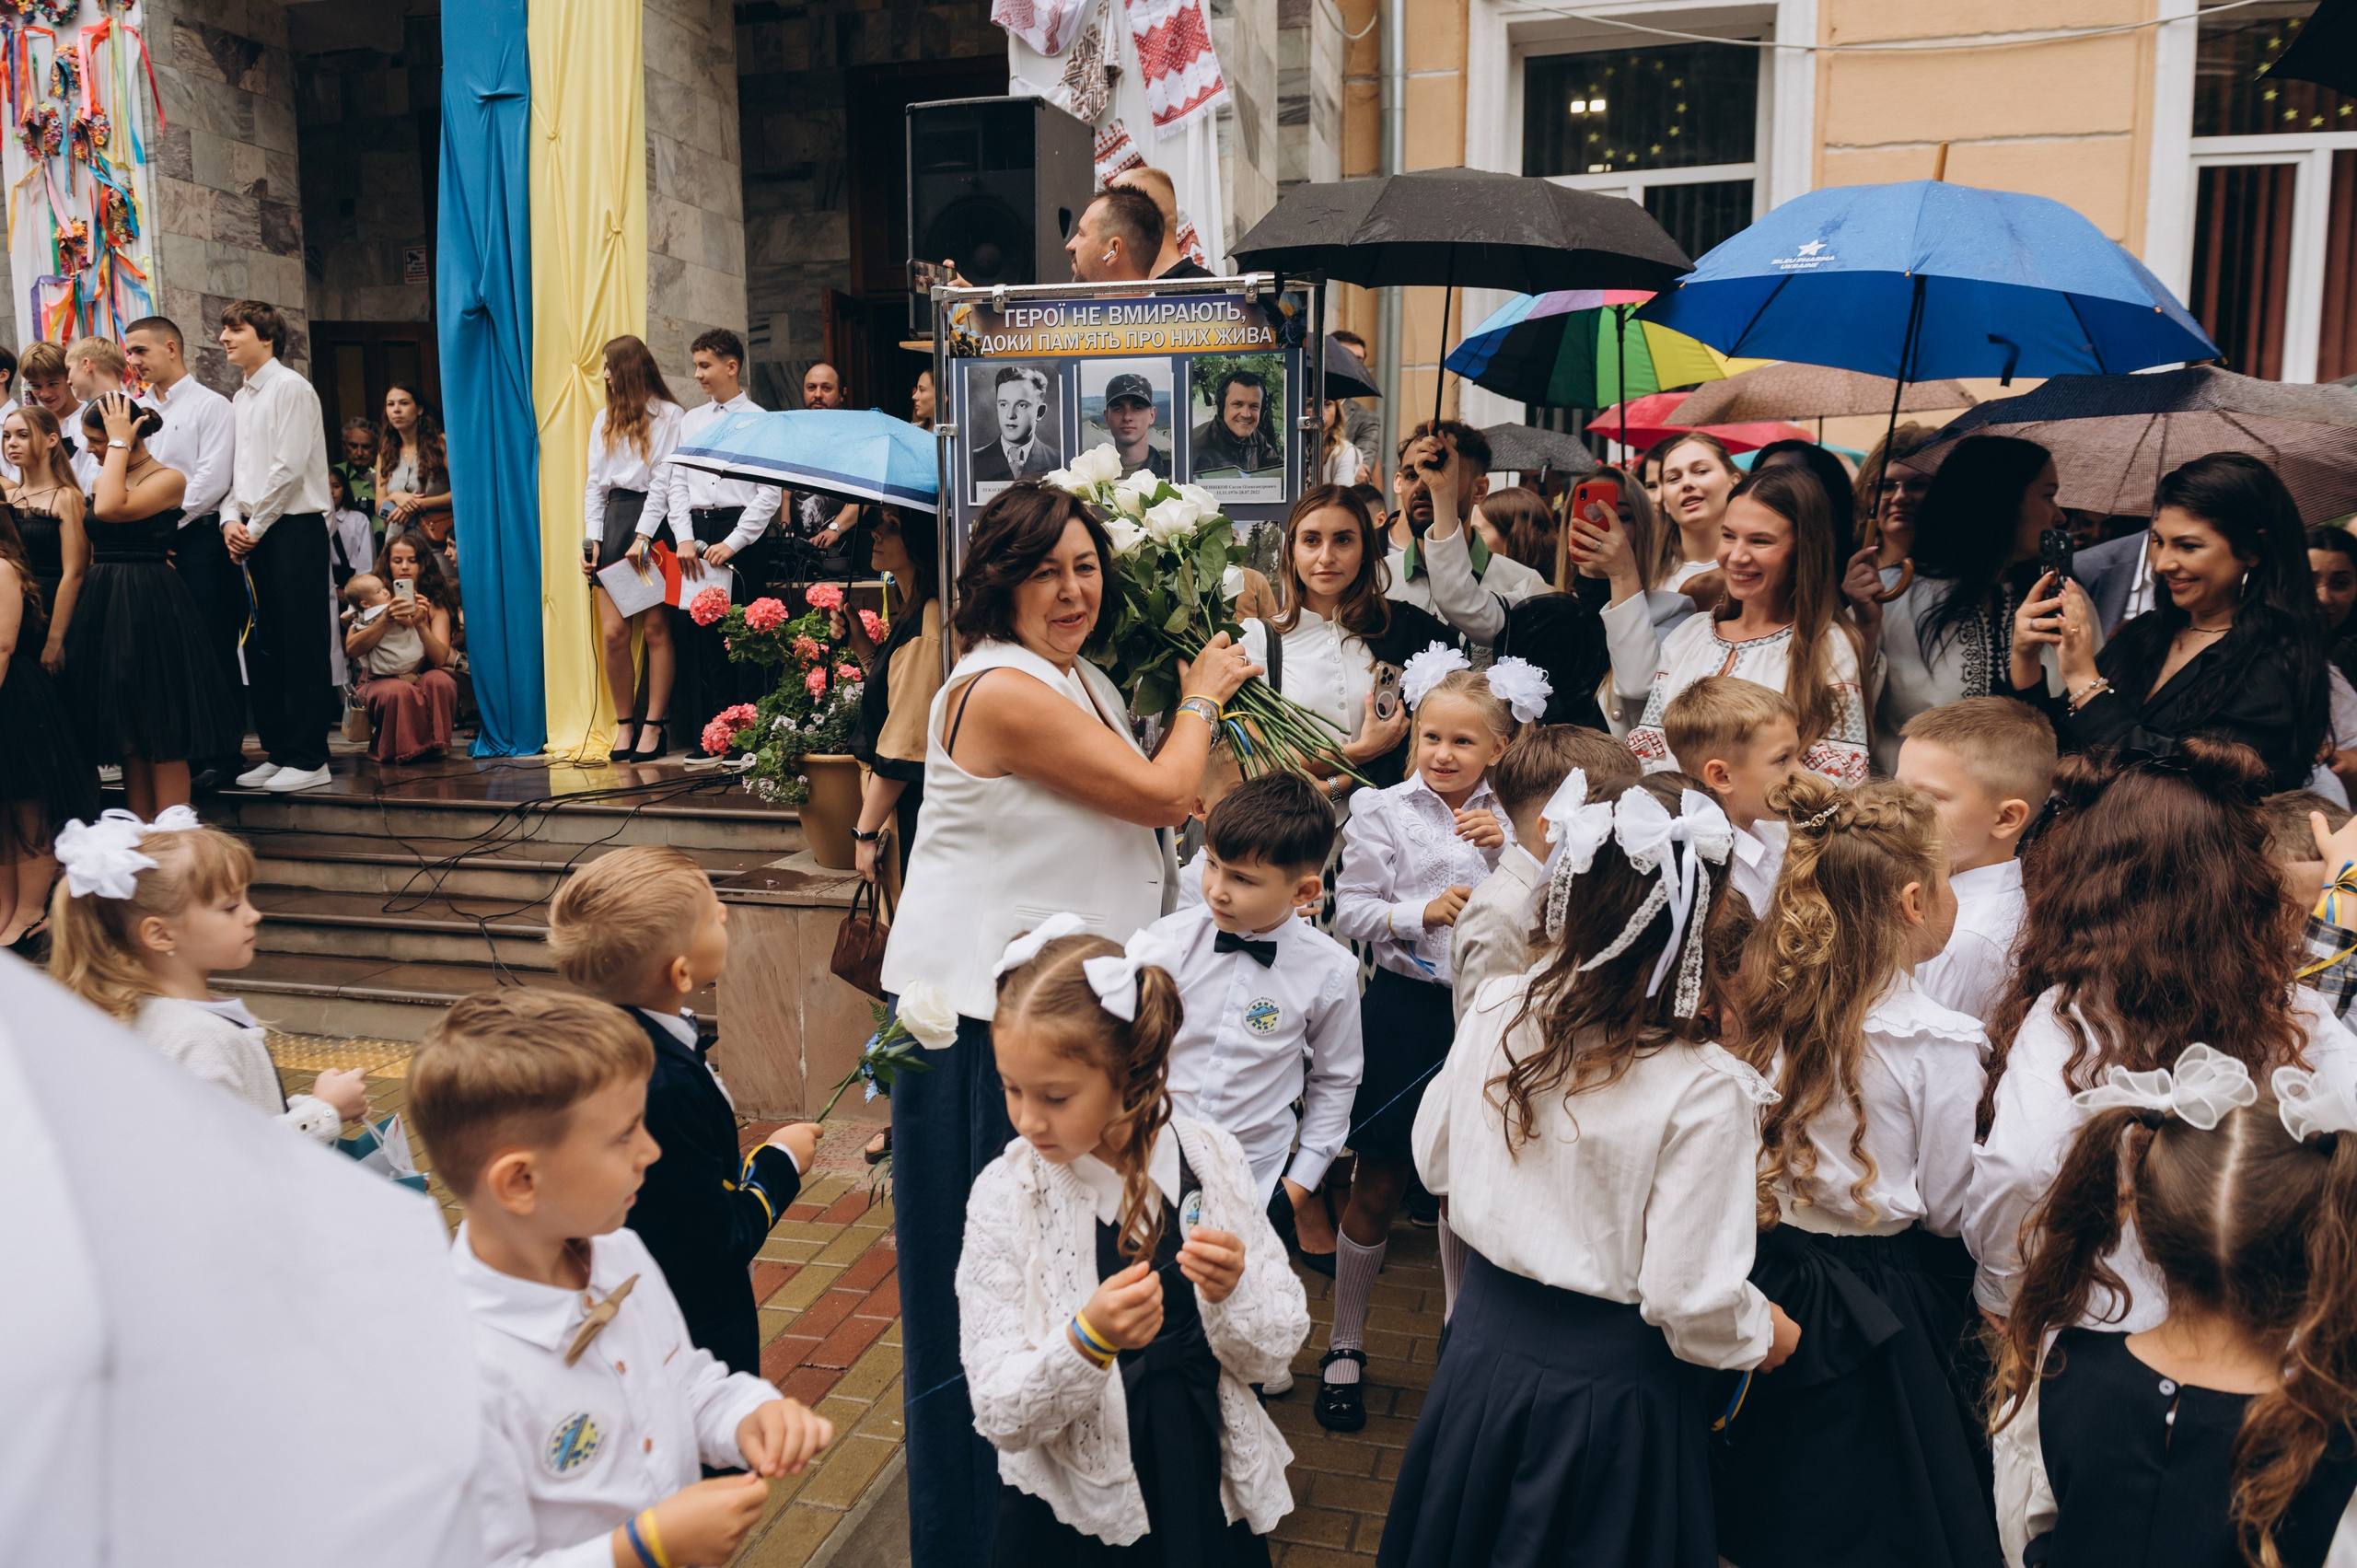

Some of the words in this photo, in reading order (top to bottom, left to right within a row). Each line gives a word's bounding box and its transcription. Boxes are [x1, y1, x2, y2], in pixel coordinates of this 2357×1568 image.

[1004, 302, 1066, 329] ГЕРОЇ
[1073, 306, 1102, 326] НЕ
[1109, 301, 1248, 325] ВМИРАЮТЬ,
[981, 333, 1032, 355] ДОКИ
[1126, 330, 1165, 349] ПРО
[1170, 328, 1210, 347] НИХ
[1214, 326, 1273, 345] ЖИВА
